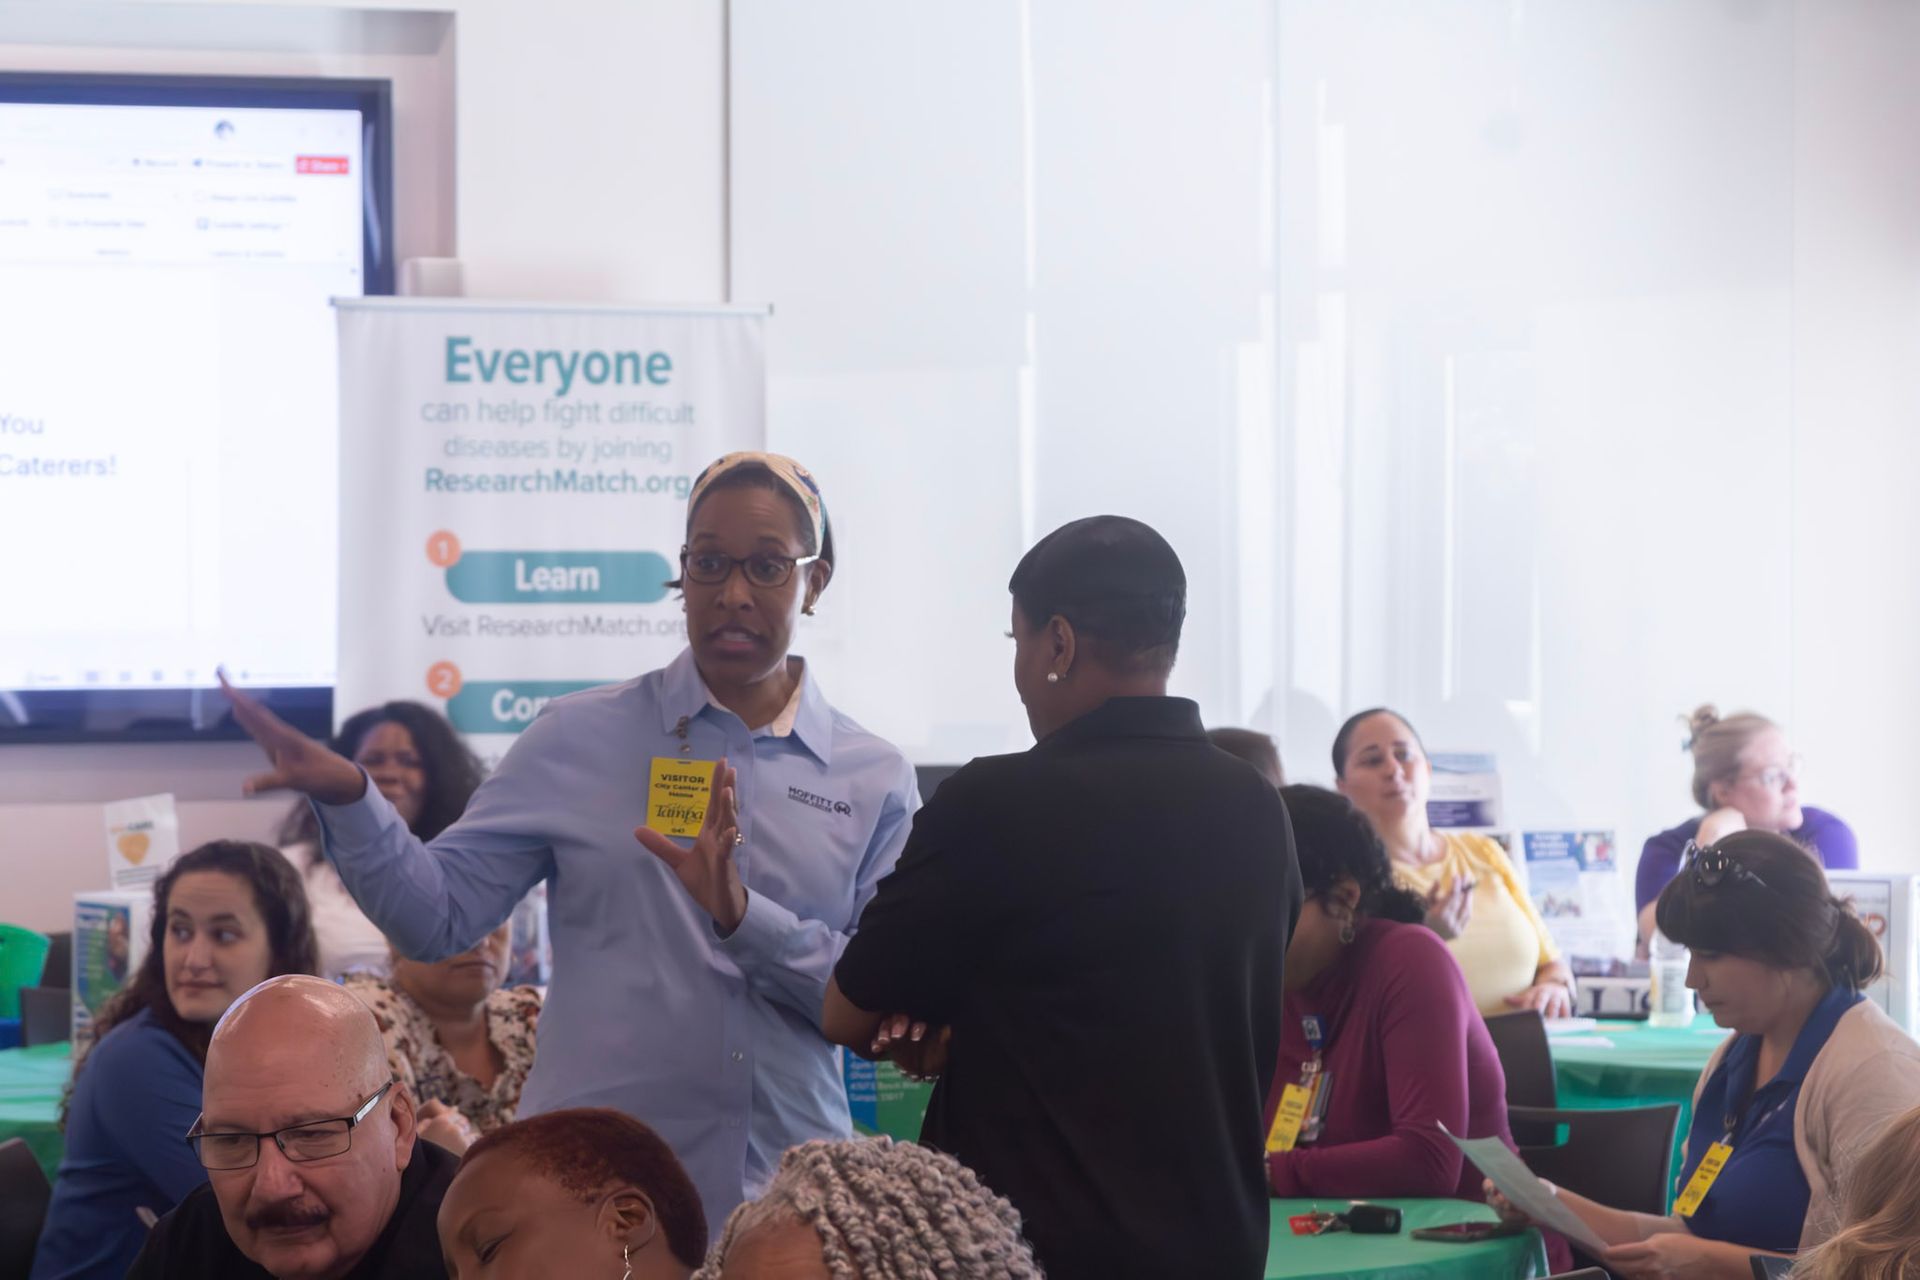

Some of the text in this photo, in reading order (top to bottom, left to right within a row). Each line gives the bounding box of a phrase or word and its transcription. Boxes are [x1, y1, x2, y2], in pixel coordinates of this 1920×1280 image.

[445, 335, 673, 397] Everyone
[0, 413, 44, 434] You
[421, 398, 695, 430] can help fight difficult
[443, 437, 672, 464] diseases by joining
[0, 454, 117, 476] Caterers!
[425, 468, 690, 500] ResearchMatch.org
[437, 540, 448, 561] 1
[515, 559, 600, 591] Learn
[421, 615, 471, 637] Visit
[437, 669, 453, 691] 2
[660, 773, 705, 784] VISITOR
[788, 785, 833, 807] MOFFITT
[655, 804, 704, 824] Tampa
